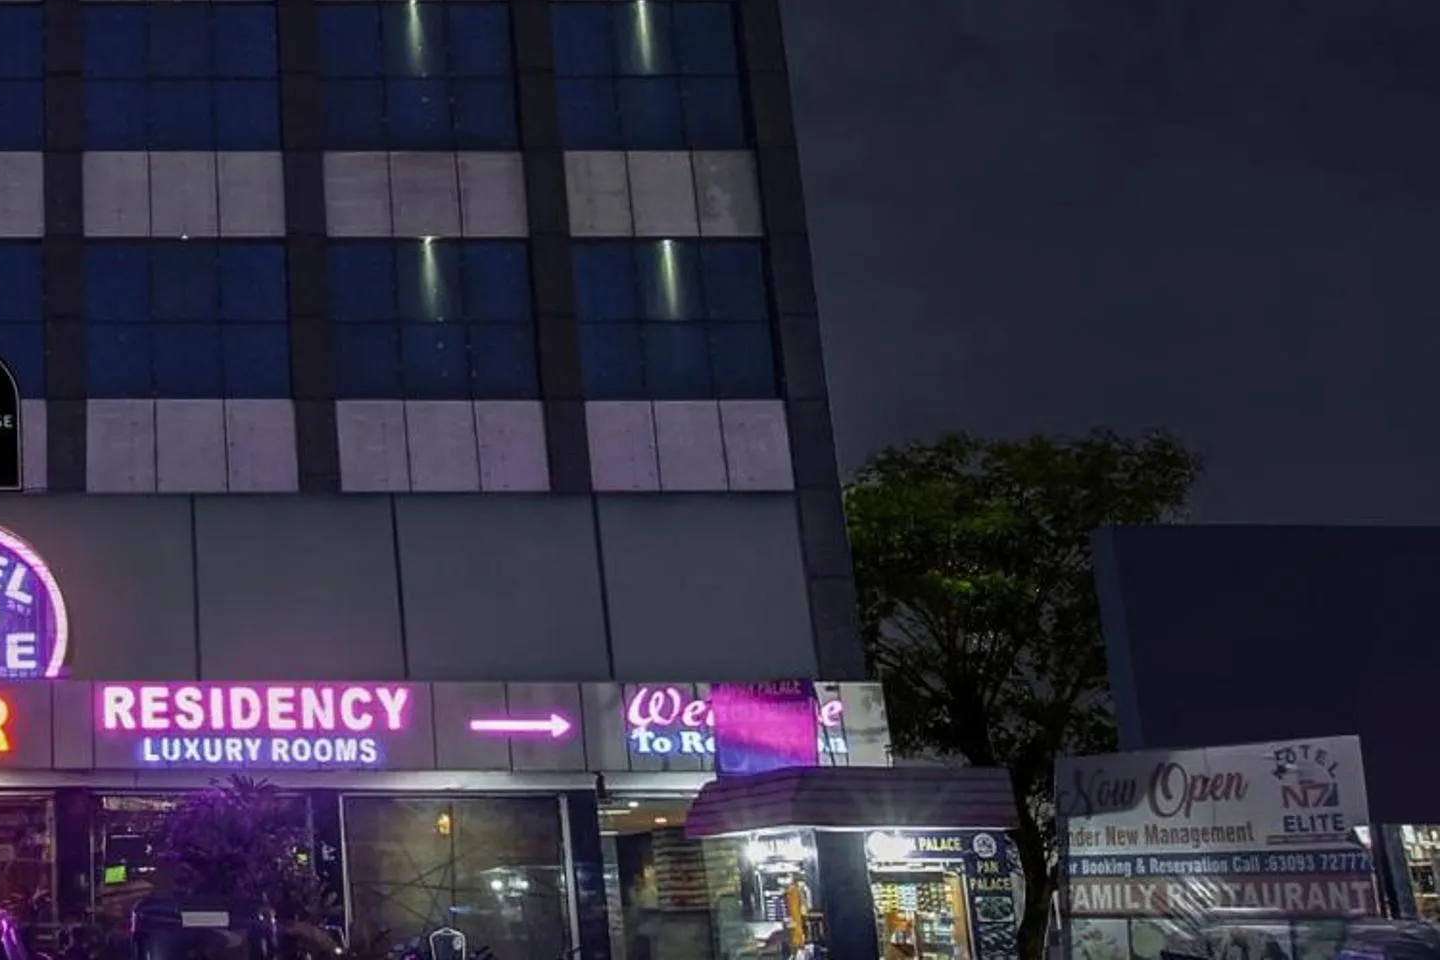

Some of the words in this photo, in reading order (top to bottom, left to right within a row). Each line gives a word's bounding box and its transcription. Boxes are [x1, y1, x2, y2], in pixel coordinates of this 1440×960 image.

[102, 686, 410, 731] RESIDENCY
[143, 737, 260, 763] LUXURY
[271, 737, 378, 763] ROOMS
[630, 729, 672, 753] To
[1146, 761, 1250, 819] Open
[1069, 827, 1102, 846] nder
[1145, 821, 1254, 848] Management
[1283, 813, 1345, 833] ELITE
[1069, 883, 1156, 910] AMILY
